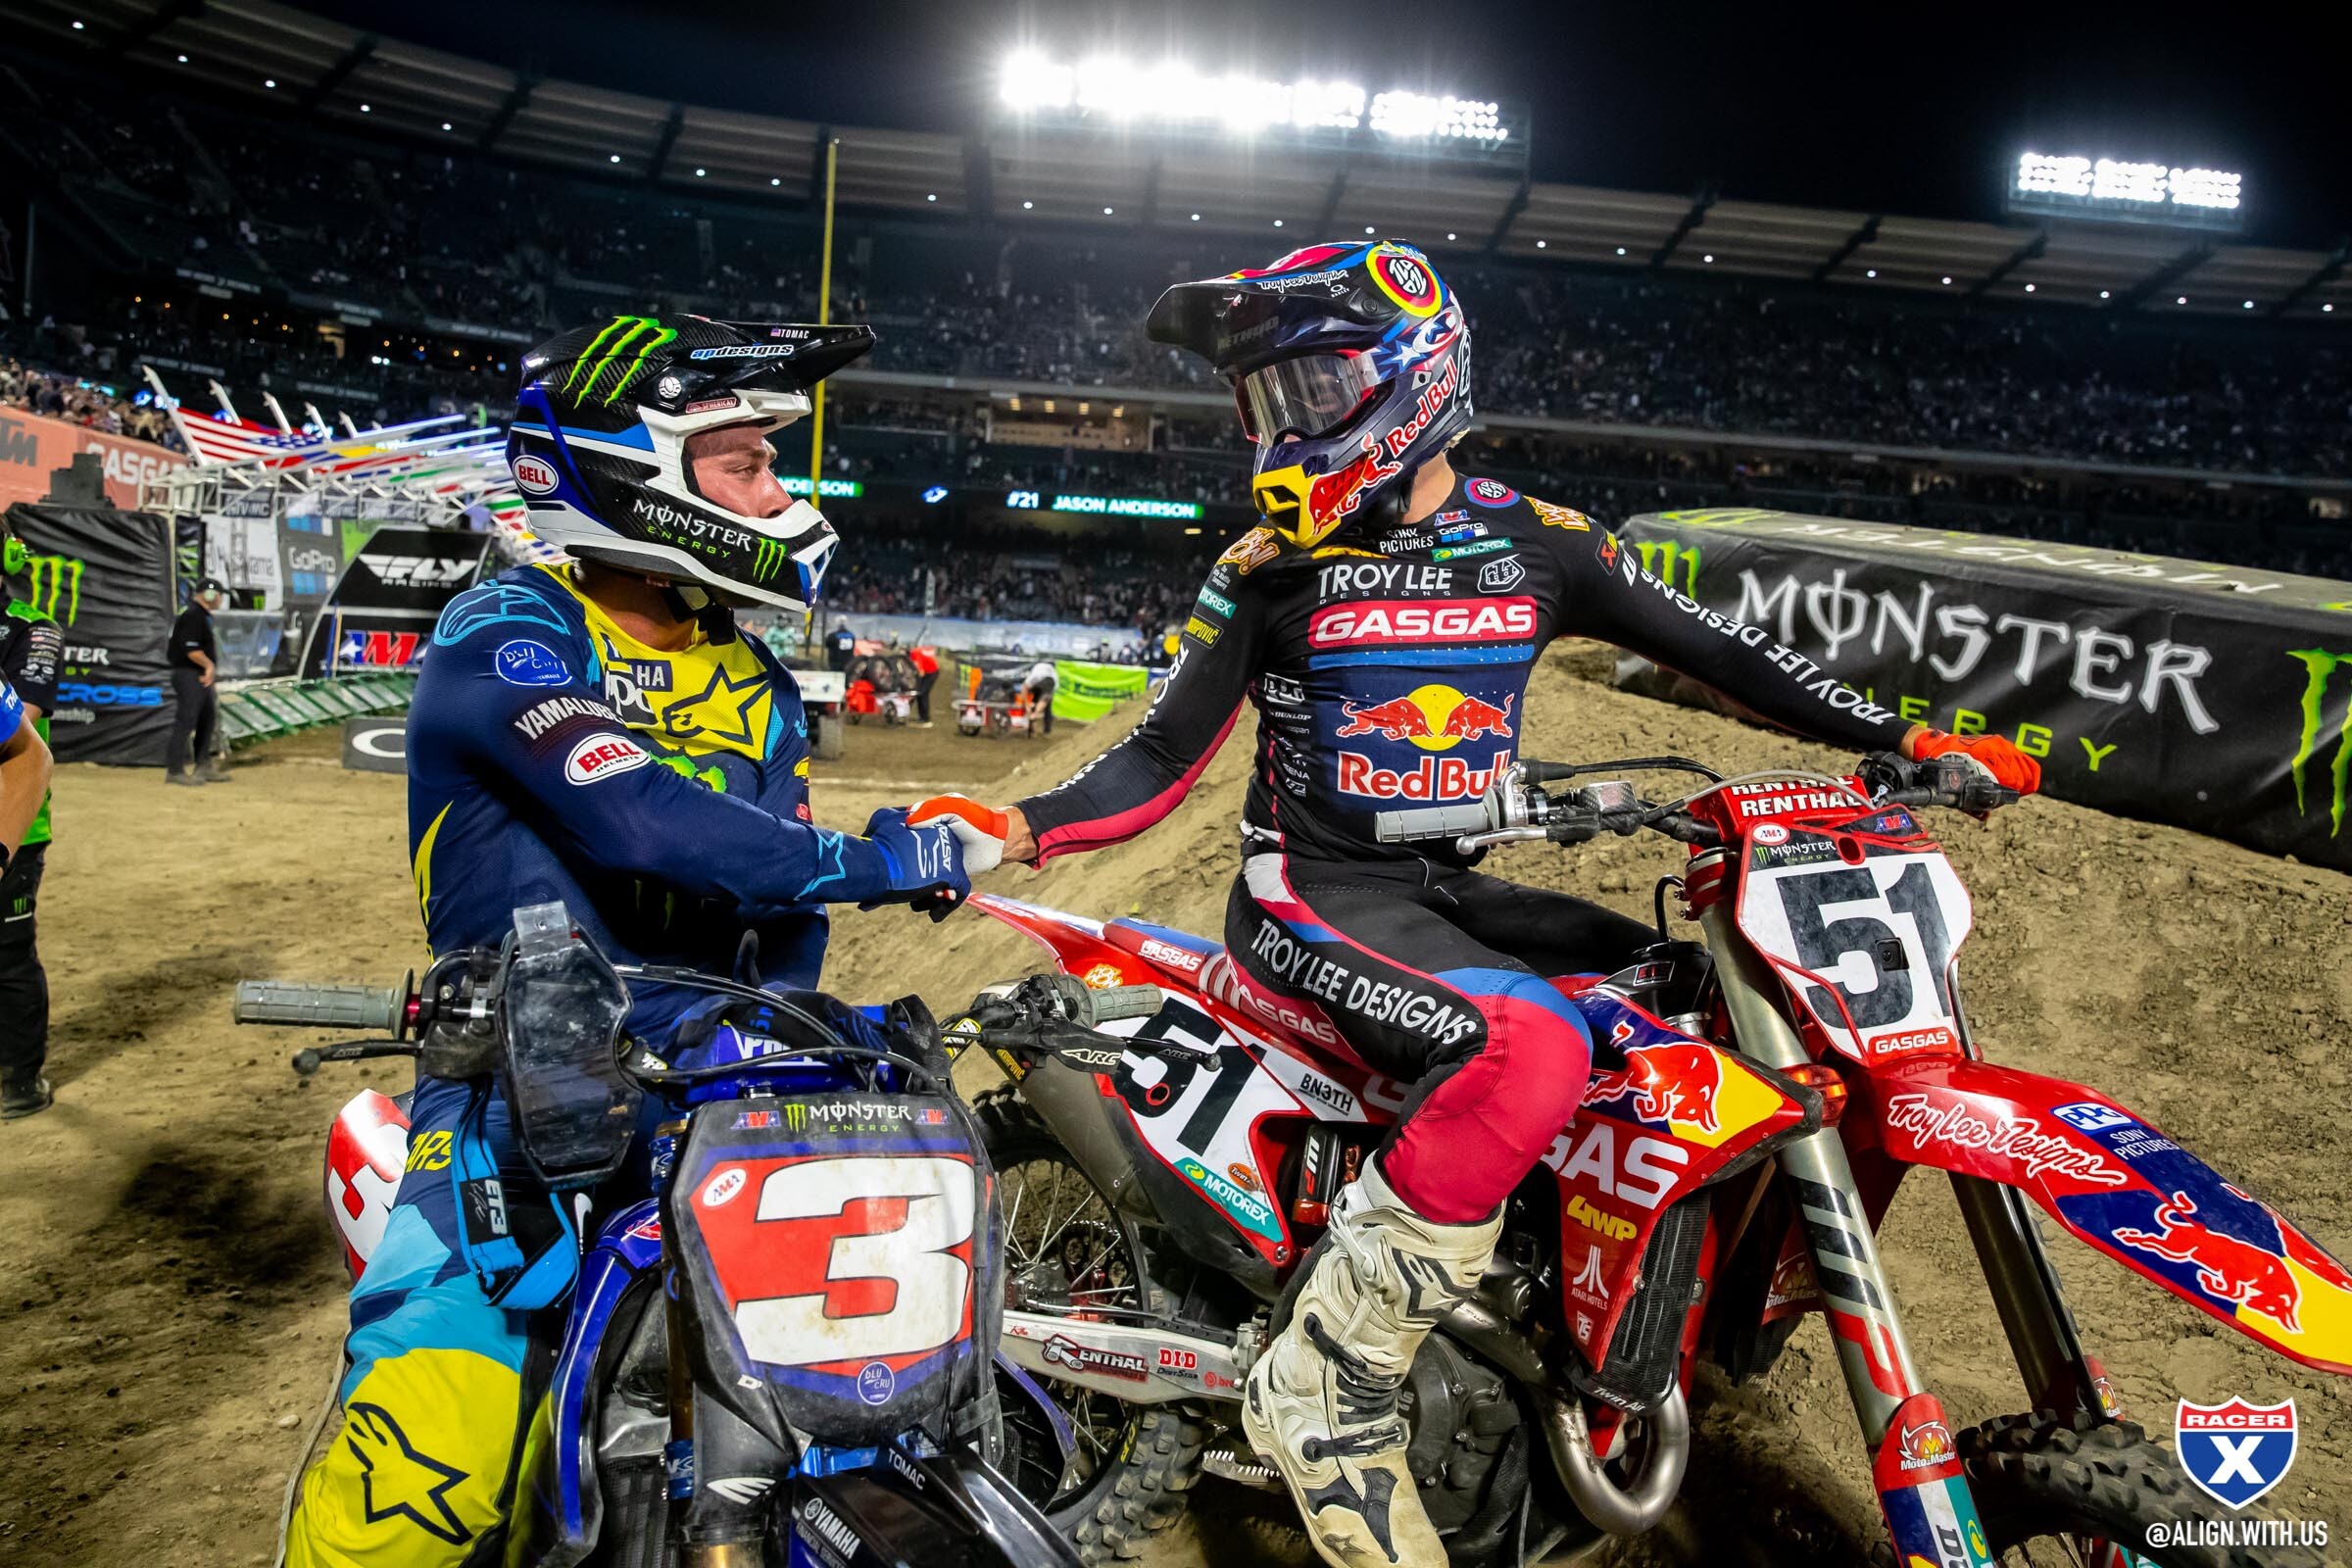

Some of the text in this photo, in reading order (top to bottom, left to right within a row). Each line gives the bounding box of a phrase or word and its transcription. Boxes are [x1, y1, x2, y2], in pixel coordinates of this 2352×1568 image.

[780, 328, 810, 339] TOMAC
[690, 344, 795, 360] apdesigns
[1386, 354, 1459, 459] Red Bull
[518, 466, 550, 486] BELL
[1007, 491, 1197, 518] #21 JASON ANDERSON
[633, 500, 752, 552] MONSTER
[1439, 522, 1484, 535] GoPro
[647, 525, 730, 559] ENERGY
[1380, 535, 1434, 554] PICTURES
[1451, 540, 1510, 558] MOTOREX
[287, 547, 336, 574] GoPro
[359, 554, 478, 581] FLY
[1318, 564, 1452, 598] TROY LEE
[1319, 590, 1451, 606] DESIGNS
[1316, 605, 1532, 644] GASGAS
[64, 646, 110, 665] TER
[1641, 568, 1896, 725] TROY LEE DESIGNS
[1735, 569, 2219, 734] MONSTER
[1275, 711, 1311, 720] DUNLOP
[1841, 682, 2118, 771] ERGY
[577, 742, 642, 773] BELL
[596, 756, 641, 773] HELMETS
[1338, 751, 1435, 801] Red
[1740, 792, 1862, 817] RENTHAL
[1874, 813, 1912, 832] AMA
[1770, 840, 1837, 858] MONSTER
[1784, 854, 1830, 863] ENERGY
[1141, 940, 1202, 972] GASGAS
[1775, 862, 1951, 1030] 51
[1251, 919, 1477, 1045] TROY LEE DESIGNS
[1157, 1048, 1192, 1060] ARC
[1875, 1031, 1948, 1054] GASGAS
[1061, 1049, 1121, 1066] ARC
[1112, 997, 1267, 1157] 51
[730, 1110, 781, 1130] AMA
[809, 1101, 912, 1122] MONSTER
[915, 1108, 950, 1125] AMA
[829, 1124, 900, 1133] ENERGY
[2109, 1128, 2151, 1144] SONY
[1937, 1103, 1990, 1148] Lee
[1986, 1118, 2128, 1185] Designs
[2113, 1139, 2180, 1160] PICTURES
[712, 1174, 741, 1202] AMA
[1203, 1174, 1272, 1227] MOTOREX
[735, 1156, 976, 1365] 3
[1571, 1288, 1608, 1311] ATARI HOTELS
[1592, 1386, 1646, 1413] Twin Air
[888, 1447, 925, 1491] TOMAC
[814, 1505, 861, 1560] YAMAHA
